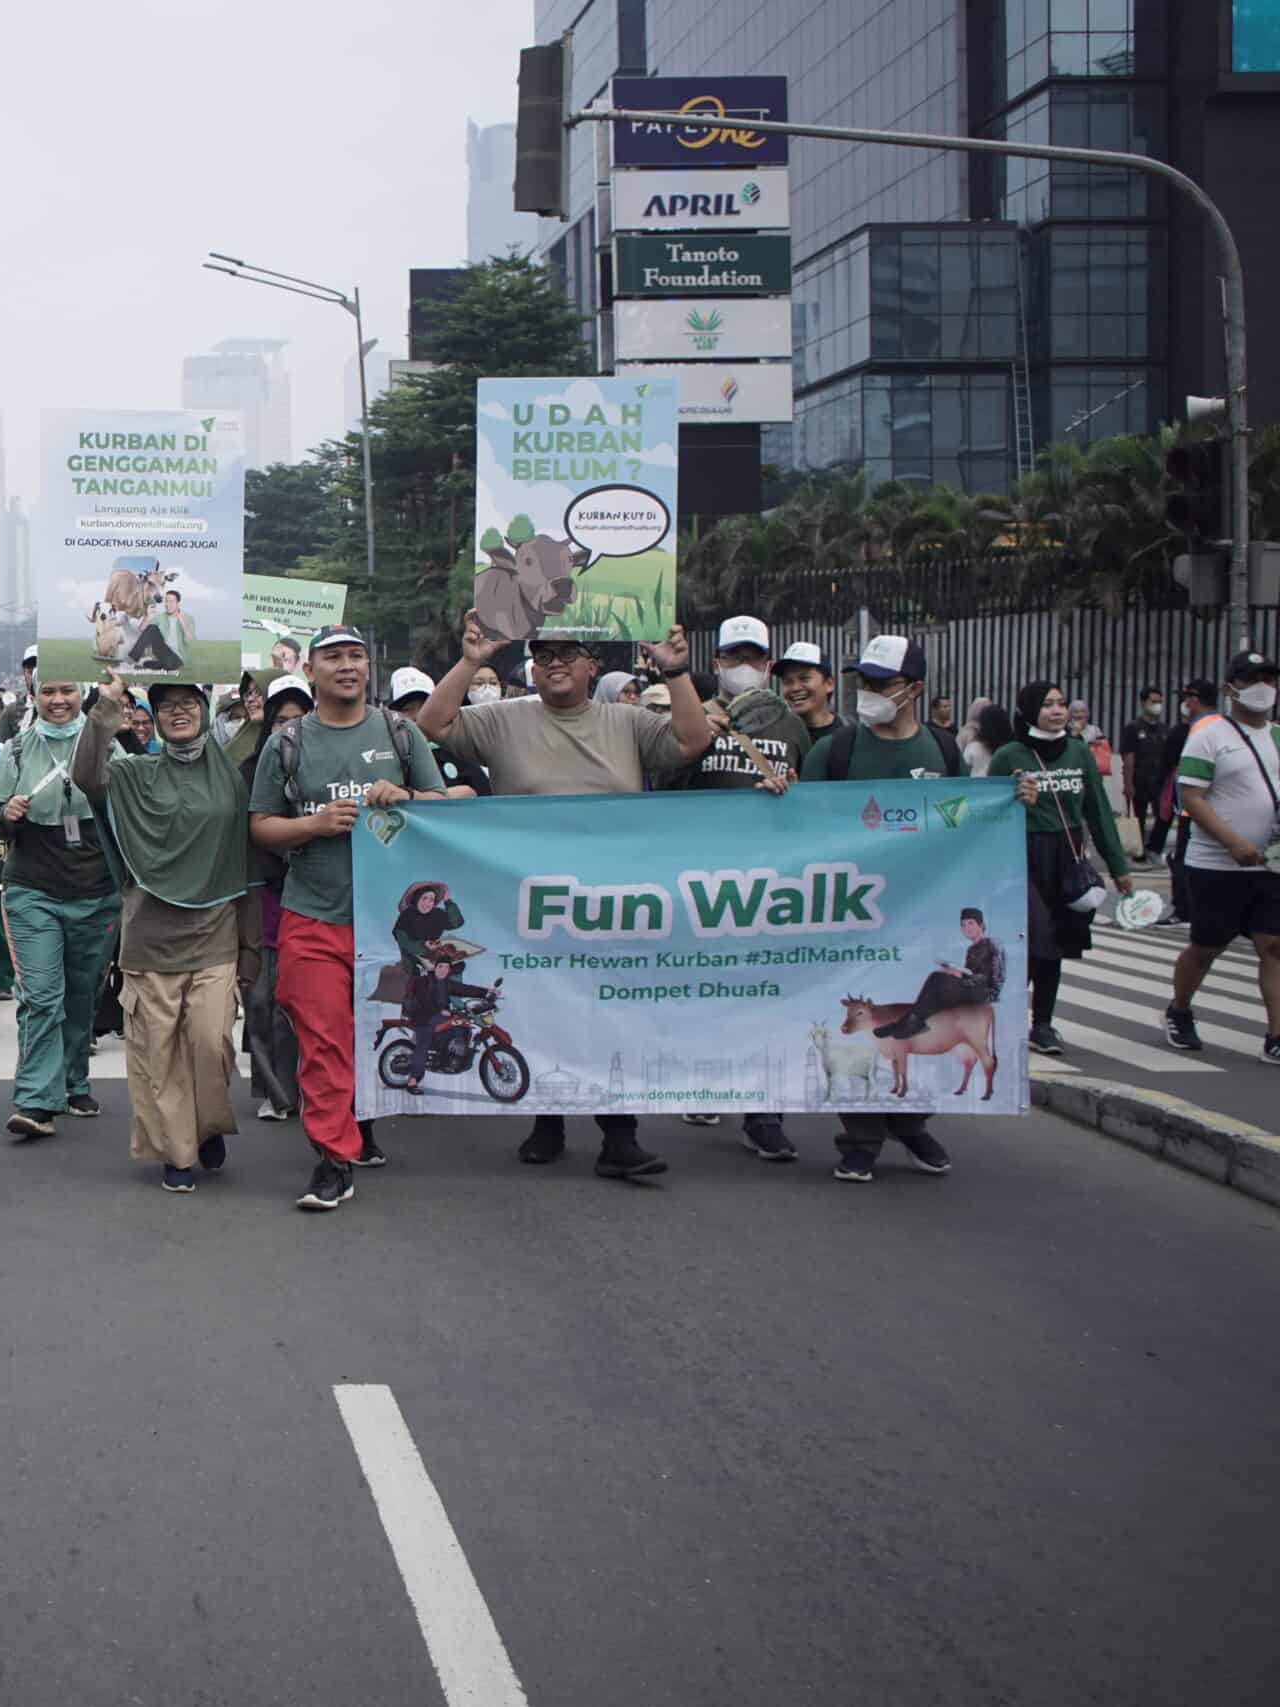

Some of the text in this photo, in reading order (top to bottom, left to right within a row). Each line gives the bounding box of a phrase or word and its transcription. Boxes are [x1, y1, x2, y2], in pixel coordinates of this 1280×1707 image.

[643, 193, 741, 217] APRIL
[665, 243, 739, 263] Tanoto
[643, 267, 763, 287] Foundation
[513, 403, 642, 426] UDAH
[79, 432, 208, 452] KURBAN DI
[513, 431, 642, 453] KURBAN
[66, 454, 218, 475] GENGGAMAN
[512, 458, 617, 481] BELUM
[578, 511, 620, 521] KURBAN
[623, 511, 644, 521] KUY
[64, 537, 76, 546] DI
[77, 538, 133, 548] GADGETMU
[135, 539, 188, 549] SEKARANG
[242, 593, 335, 610] ARI HEWAN KURBAN
[715, 735, 787, 757] APCITY
[702, 754, 789, 777] BUILDNG
[326, 780, 373, 800] Teba
[883, 808, 917, 823] C20
[526, 872, 875, 931] Fun Walk
[499, 945, 902, 970] Tebar Hewan Kurban #JadiManfaat
[599, 981, 780, 1002] Dompet Dhuafa
[609, 1088, 765, 1101] www.dompetdhuafa.org
